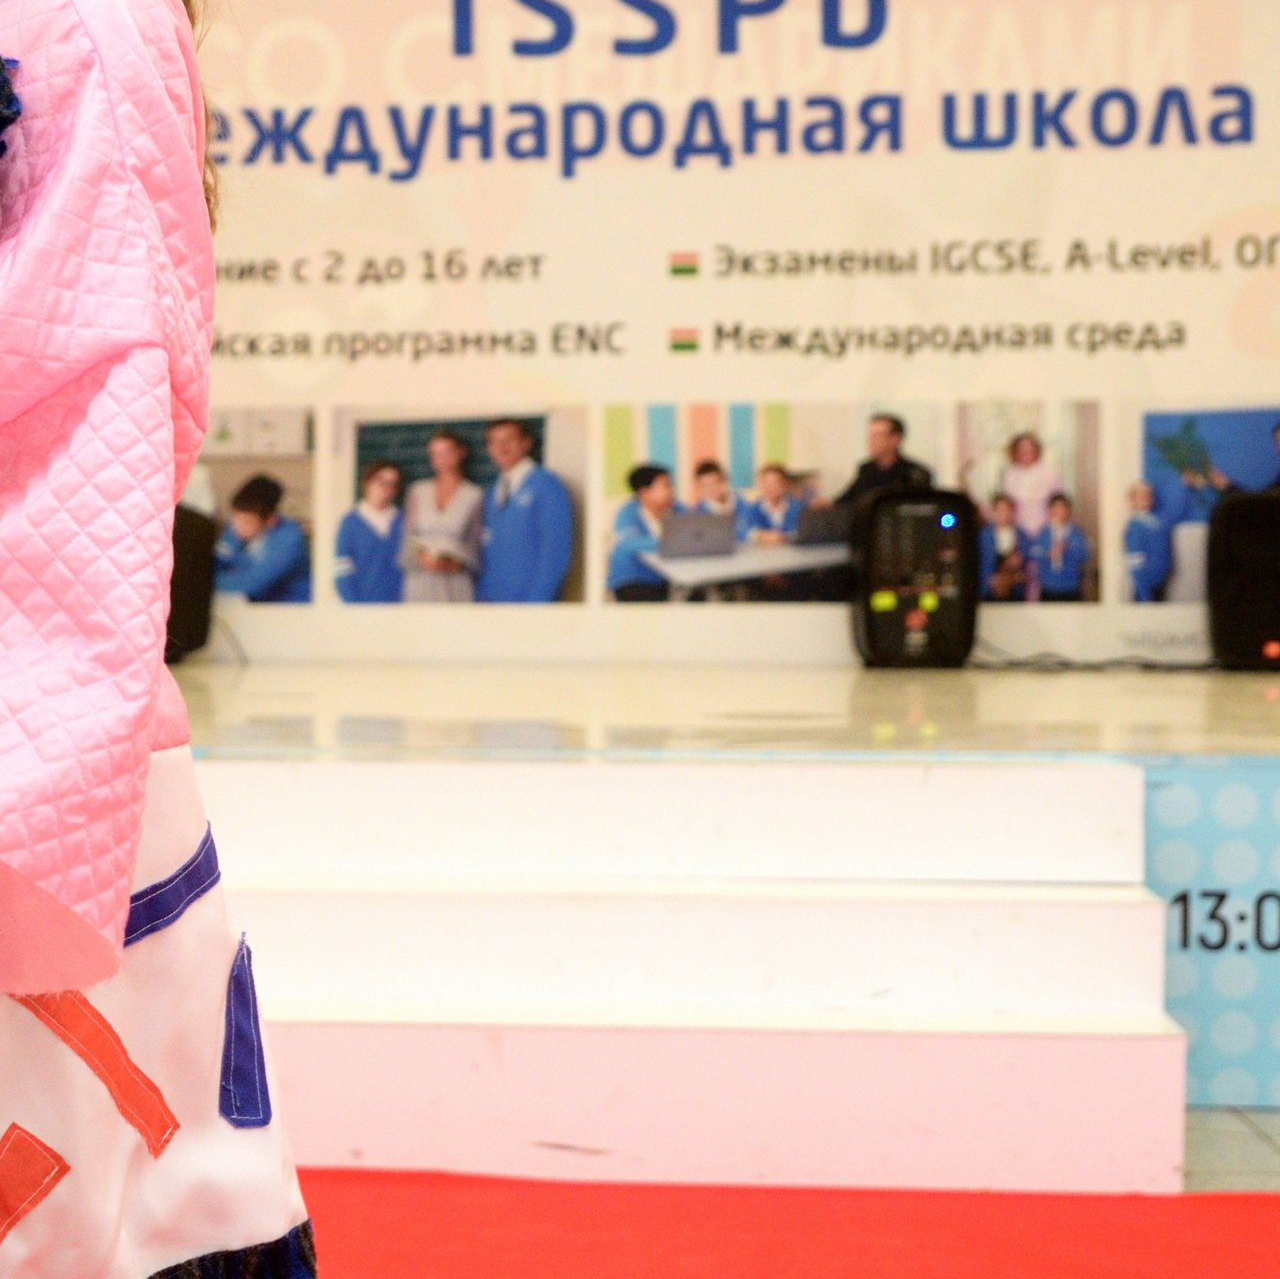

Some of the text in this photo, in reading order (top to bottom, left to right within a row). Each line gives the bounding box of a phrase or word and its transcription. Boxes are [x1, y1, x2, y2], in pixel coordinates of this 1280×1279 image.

[210, 82, 1256, 184] еждународная школа
[214, 258, 280, 284] ние
[323, 249, 345, 283] 2
[356, 253, 407, 286] до
[420, 247, 469, 283] 16
[480, 252, 546, 280] лет
[713, 241, 919, 278] Экзамены
[211, 321, 628, 363] йская программа ENC
[713, 320, 1187, 359] Международная среда
